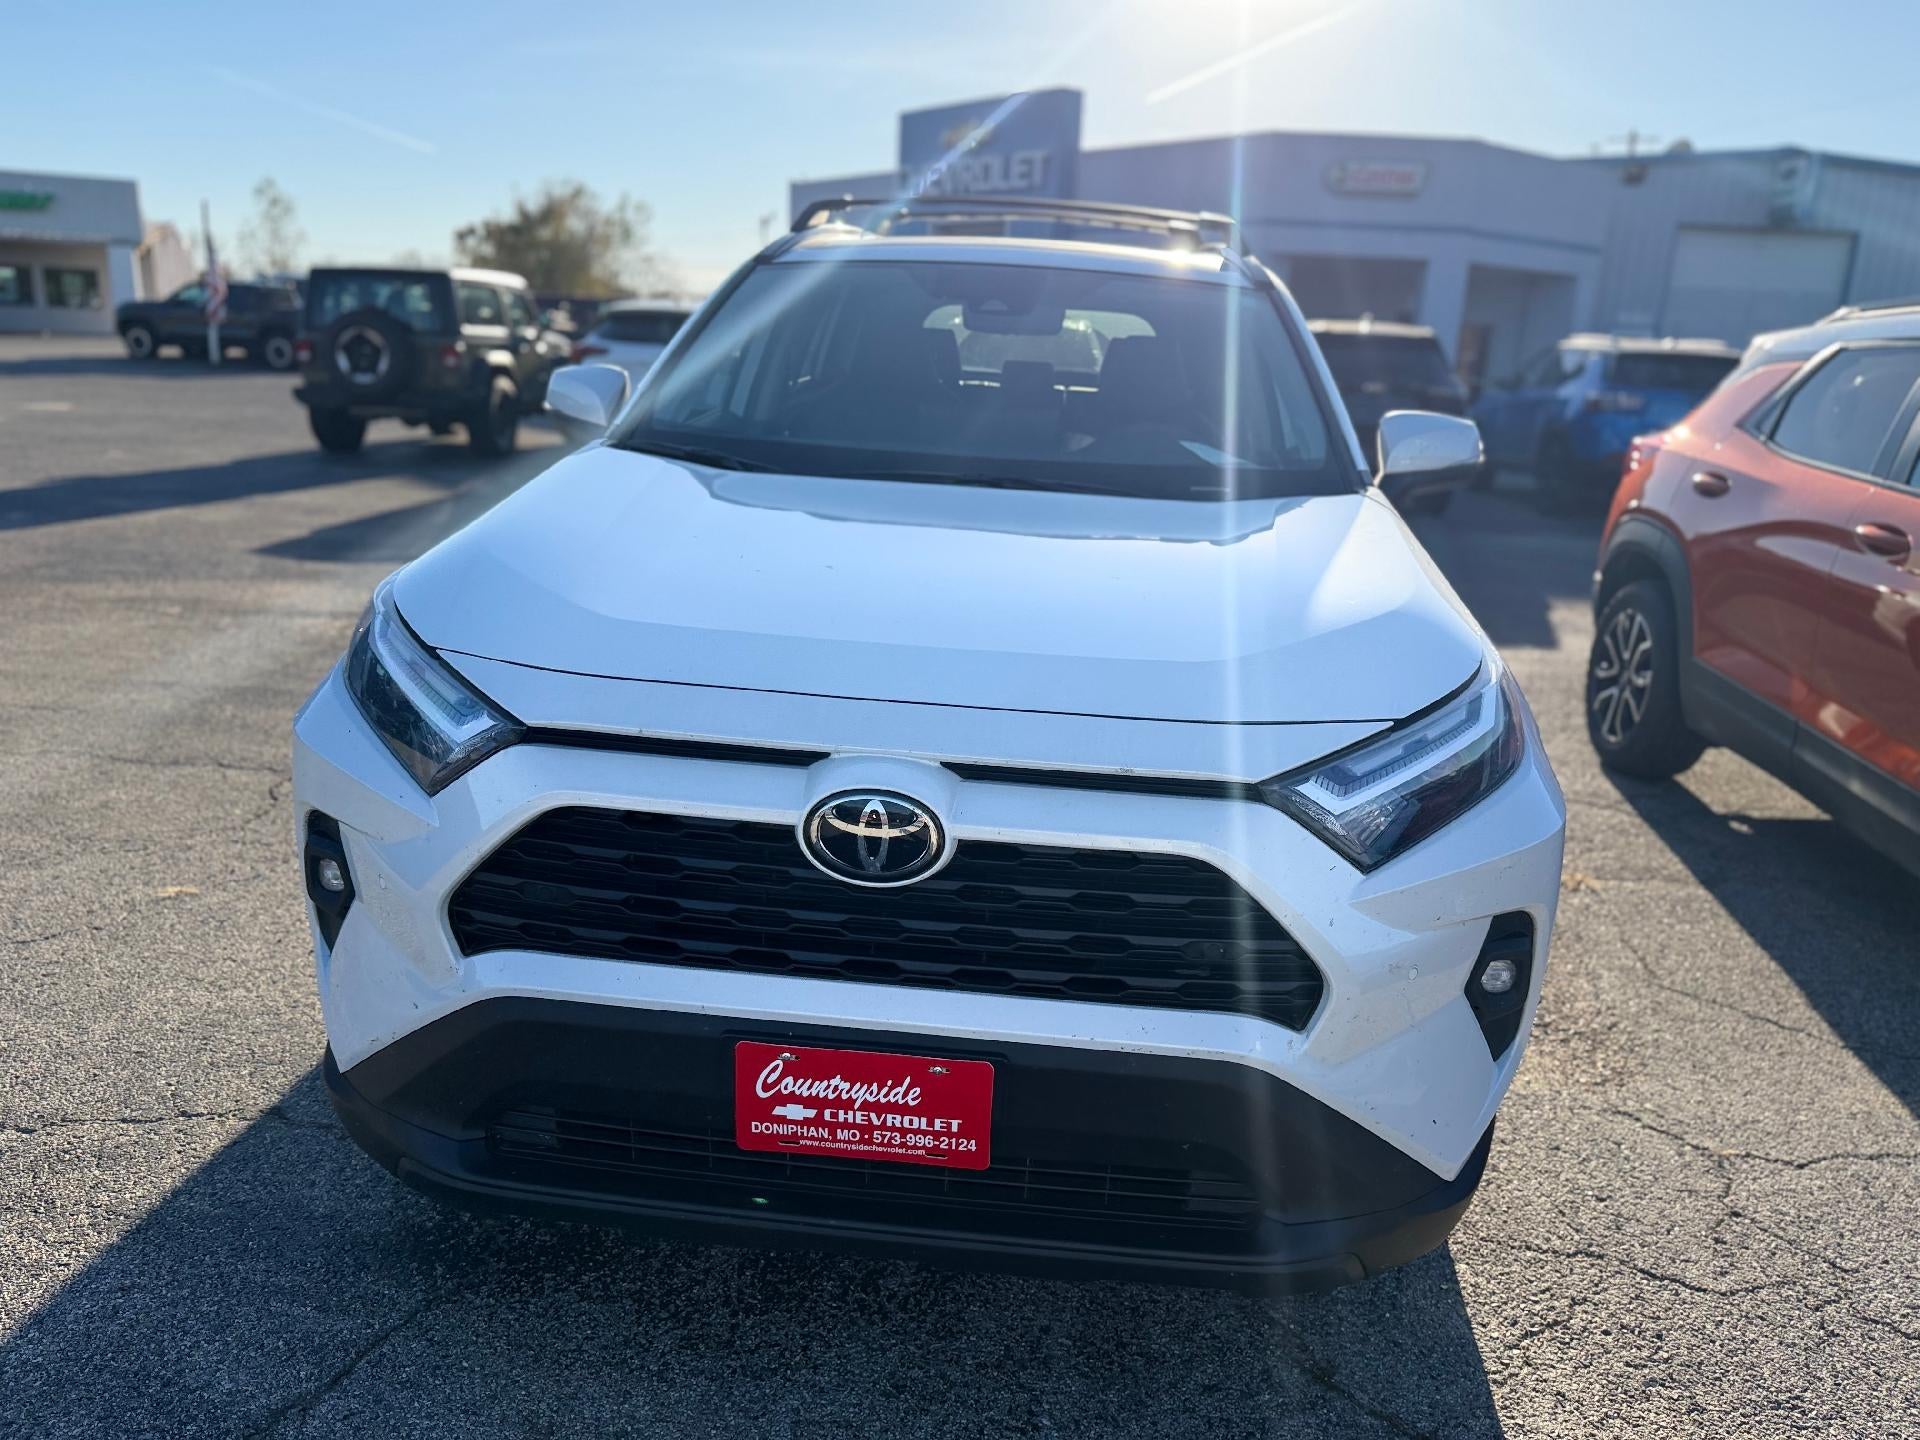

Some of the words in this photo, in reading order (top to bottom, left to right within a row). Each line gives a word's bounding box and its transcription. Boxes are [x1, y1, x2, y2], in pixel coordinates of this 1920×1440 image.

[897, 151, 1049, 198] EVROLET
[755, 1060, 922, 1109] Countryside
[823, 1108, 963, 1132] CHEVROLET
[751, 1121, 832, 1140] DONIPHAN,
[836, 1128, 860, 1141] MO
[872, 1131, 977, 1152] 573-996-2124
[799, 1139, 926, 1156] www.countrysidechevrolet.com
